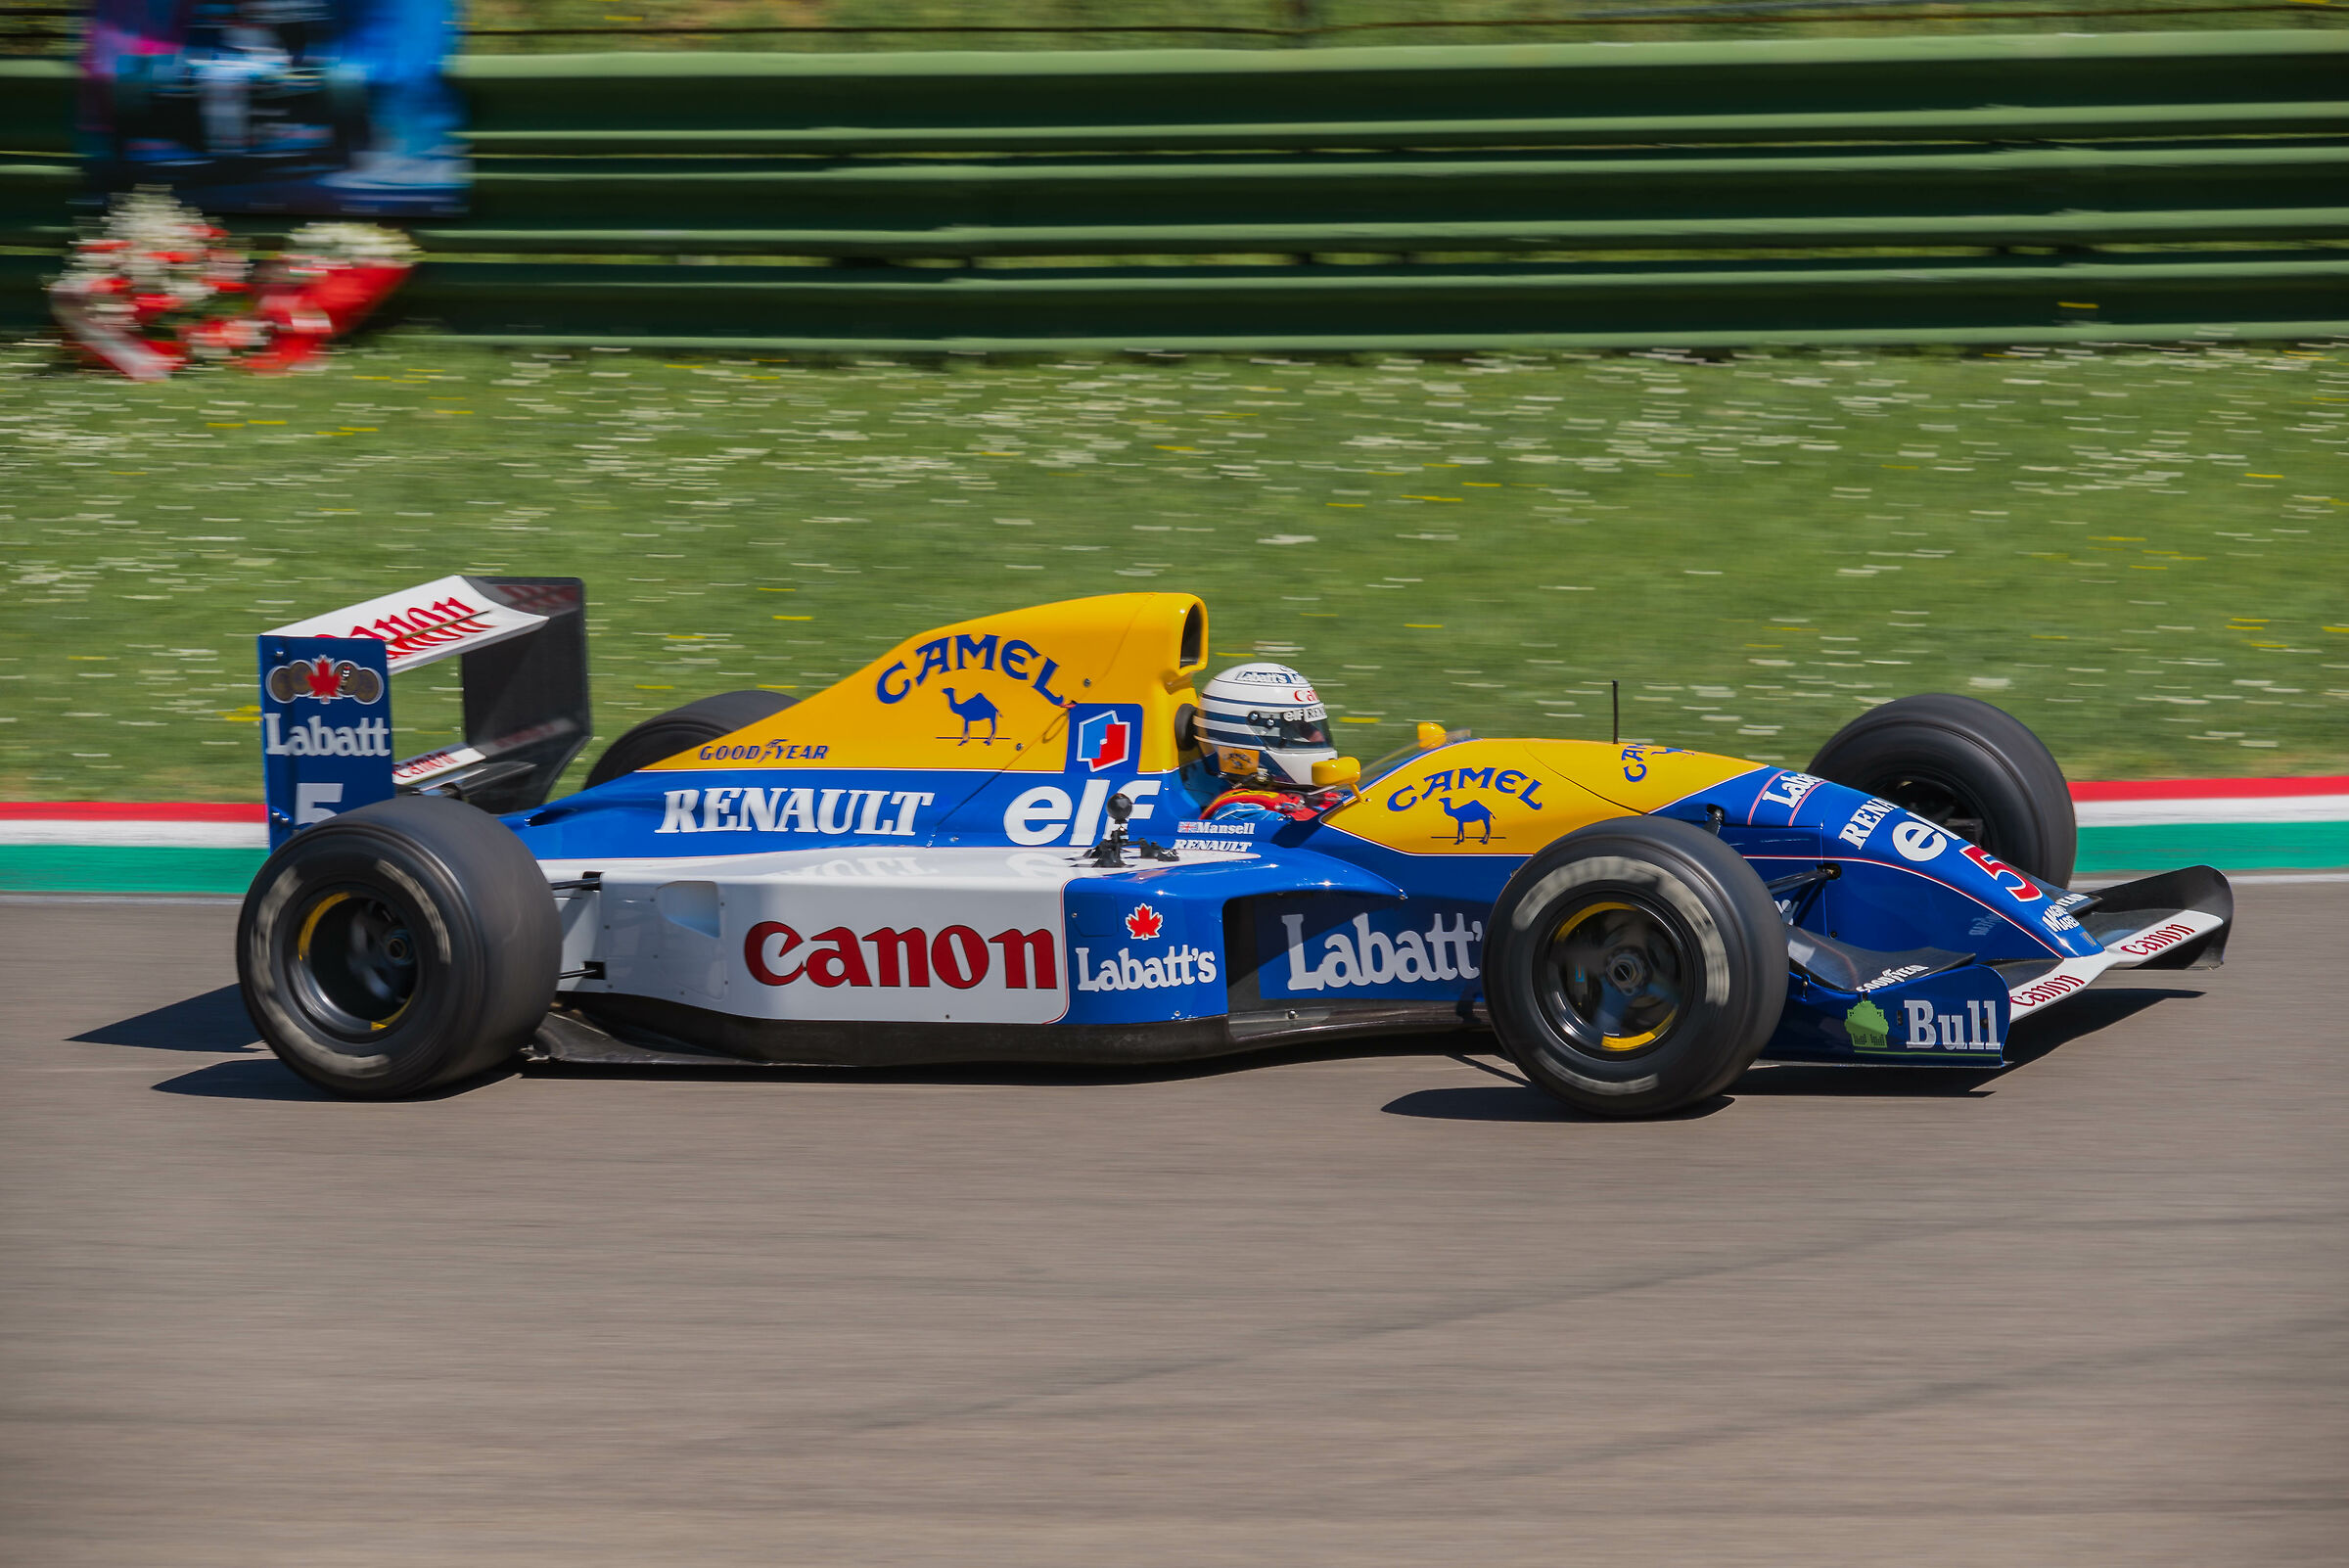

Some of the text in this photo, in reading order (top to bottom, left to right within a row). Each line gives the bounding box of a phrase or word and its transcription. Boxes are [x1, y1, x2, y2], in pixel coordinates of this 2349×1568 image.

[313, 595, 499, 660] anon
[876, 634, 1065, 705] CAMEL
[264, 713, 391, 757] Labatt
[700, 739, 830, 763] GOODYEAR
[655, 787, 935, 837] RENAULT
[1387, 766, 1543, 811] CAMEL
[1004, 779, 1162, 847] elf
[1196, 822, 1256, 835] Mansell
[1173, 839, 1253, 853] RENAULT
[1959, 844, 2043, 901] 5
[744, 921, 1058, 990] Canon
[1281, 912, 1483, 992] Labatt'
[2120, 923, 2196, 955] Canon
[1076, 945, 1217, 992] Labatt's
[2010, 975, 2086, 1007] Canon
[1904, 999, 2002, 1050] Bull
